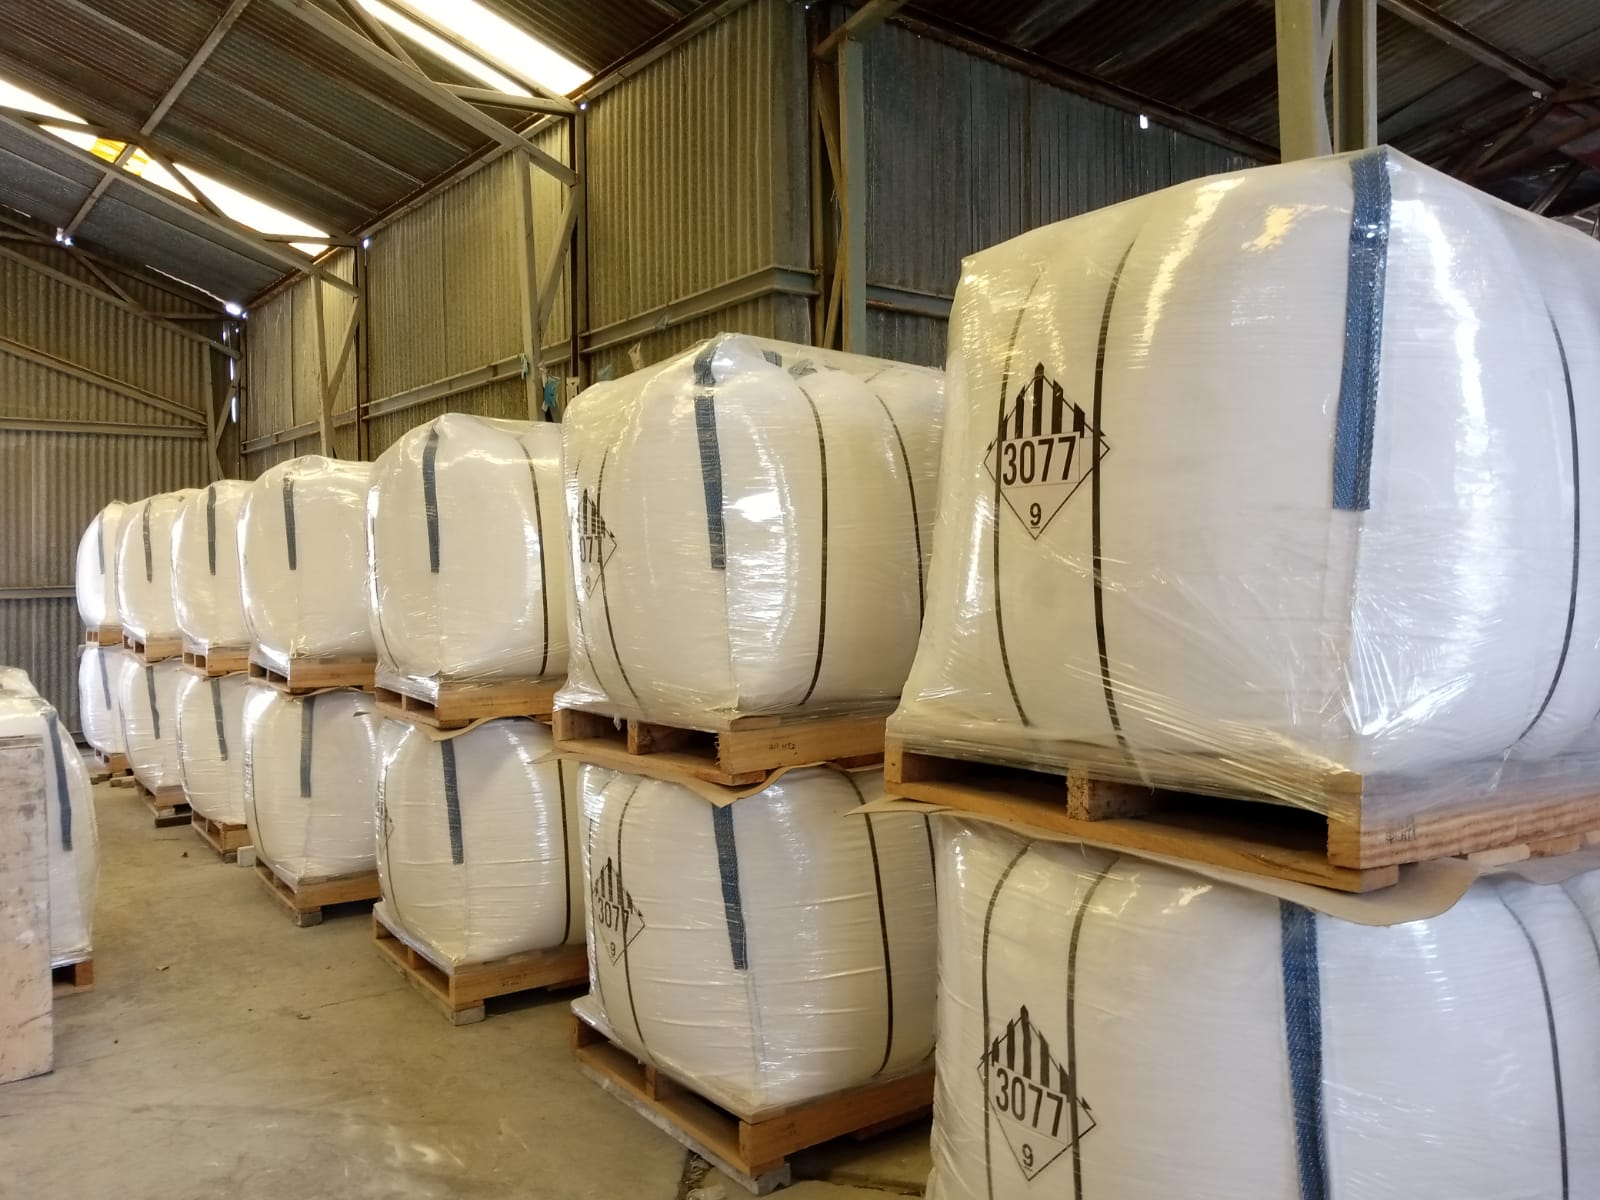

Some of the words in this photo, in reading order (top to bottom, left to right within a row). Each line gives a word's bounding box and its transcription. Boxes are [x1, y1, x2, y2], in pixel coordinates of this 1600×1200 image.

[1002, 436, 1076, 485] 3077
[1030, 503, 1042, 526] 9
[579, 536, 602, 563] 077
[598, 897, 629, 935] 3077
[610, 942, 616, 956] 9
[996, 1068, 1064, 1137] 3077
[1022, 1143, 1034, 1167] 9
